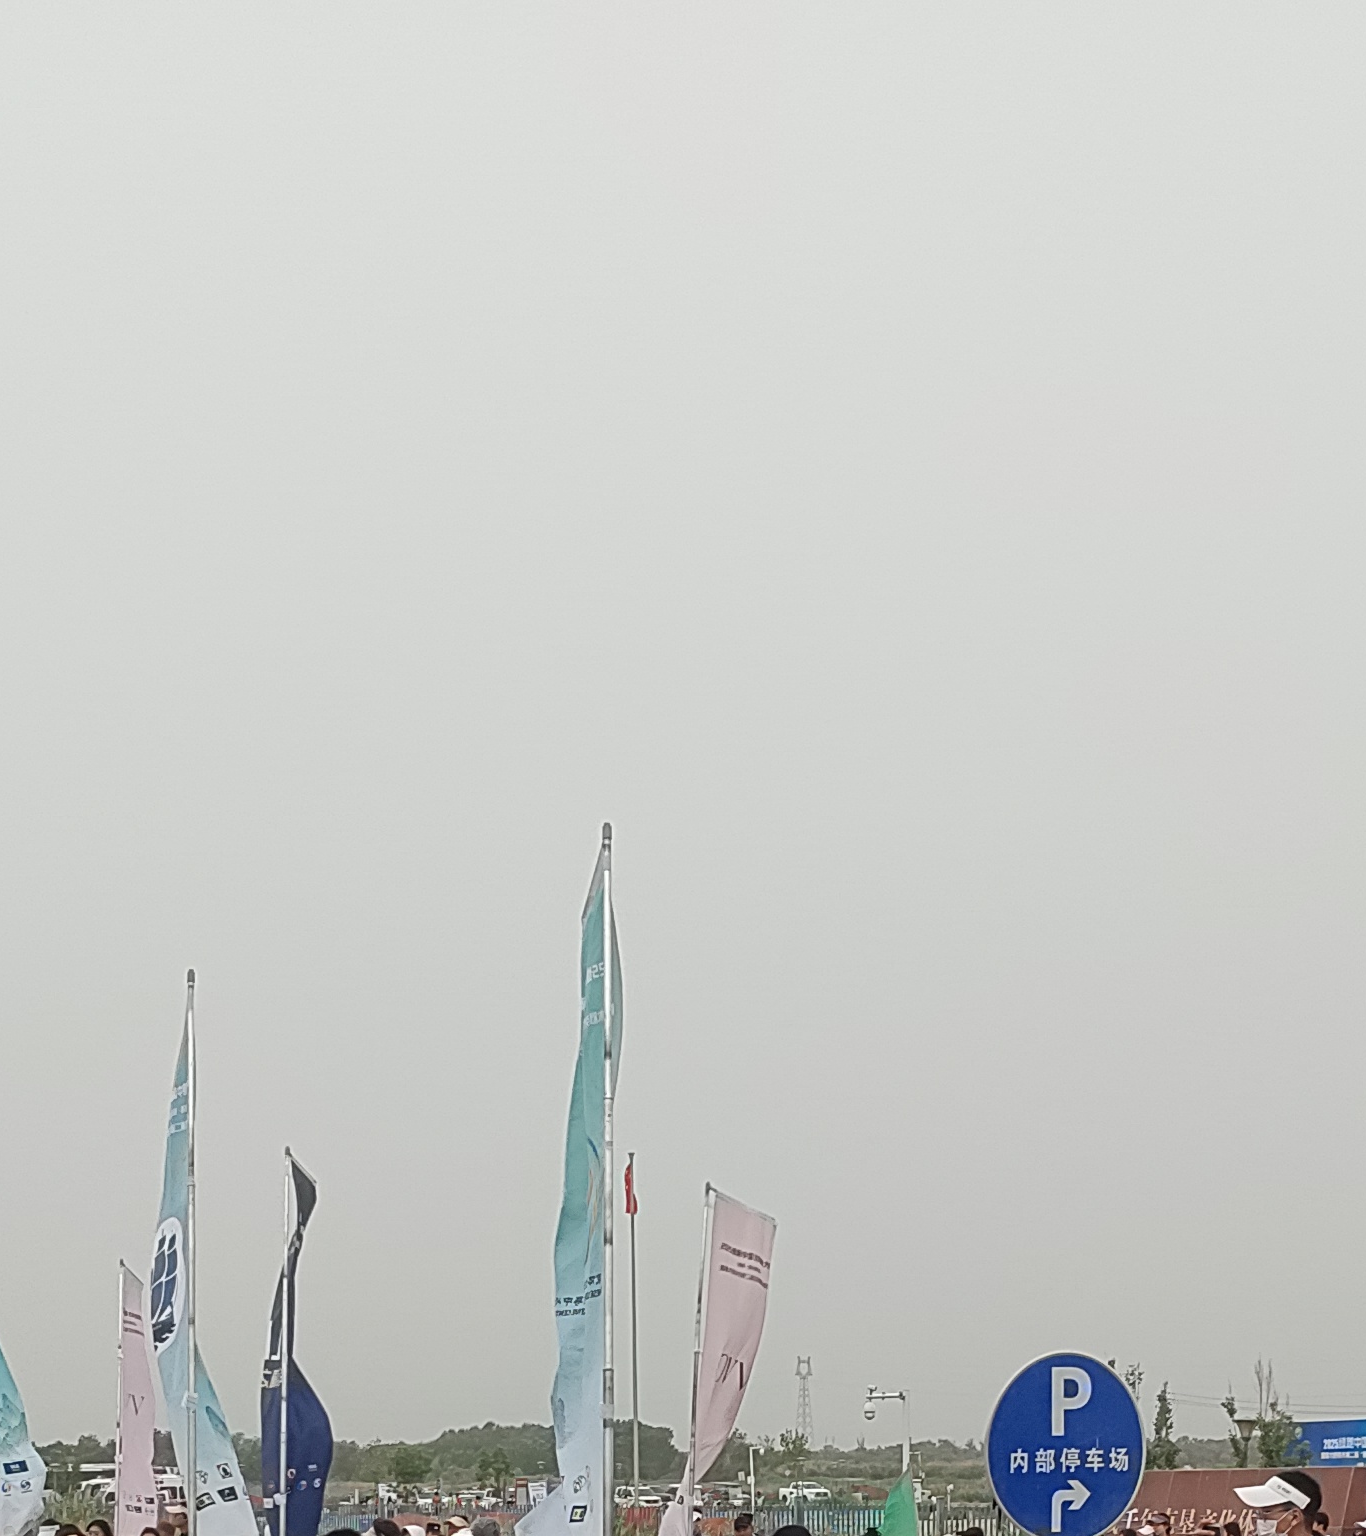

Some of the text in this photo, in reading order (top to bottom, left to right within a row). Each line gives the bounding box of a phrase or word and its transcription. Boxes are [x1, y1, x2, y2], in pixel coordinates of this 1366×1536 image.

[1051, 1366, 1092, 1437] P
[1009, 1447, 1130, 1474] 内部停车场
